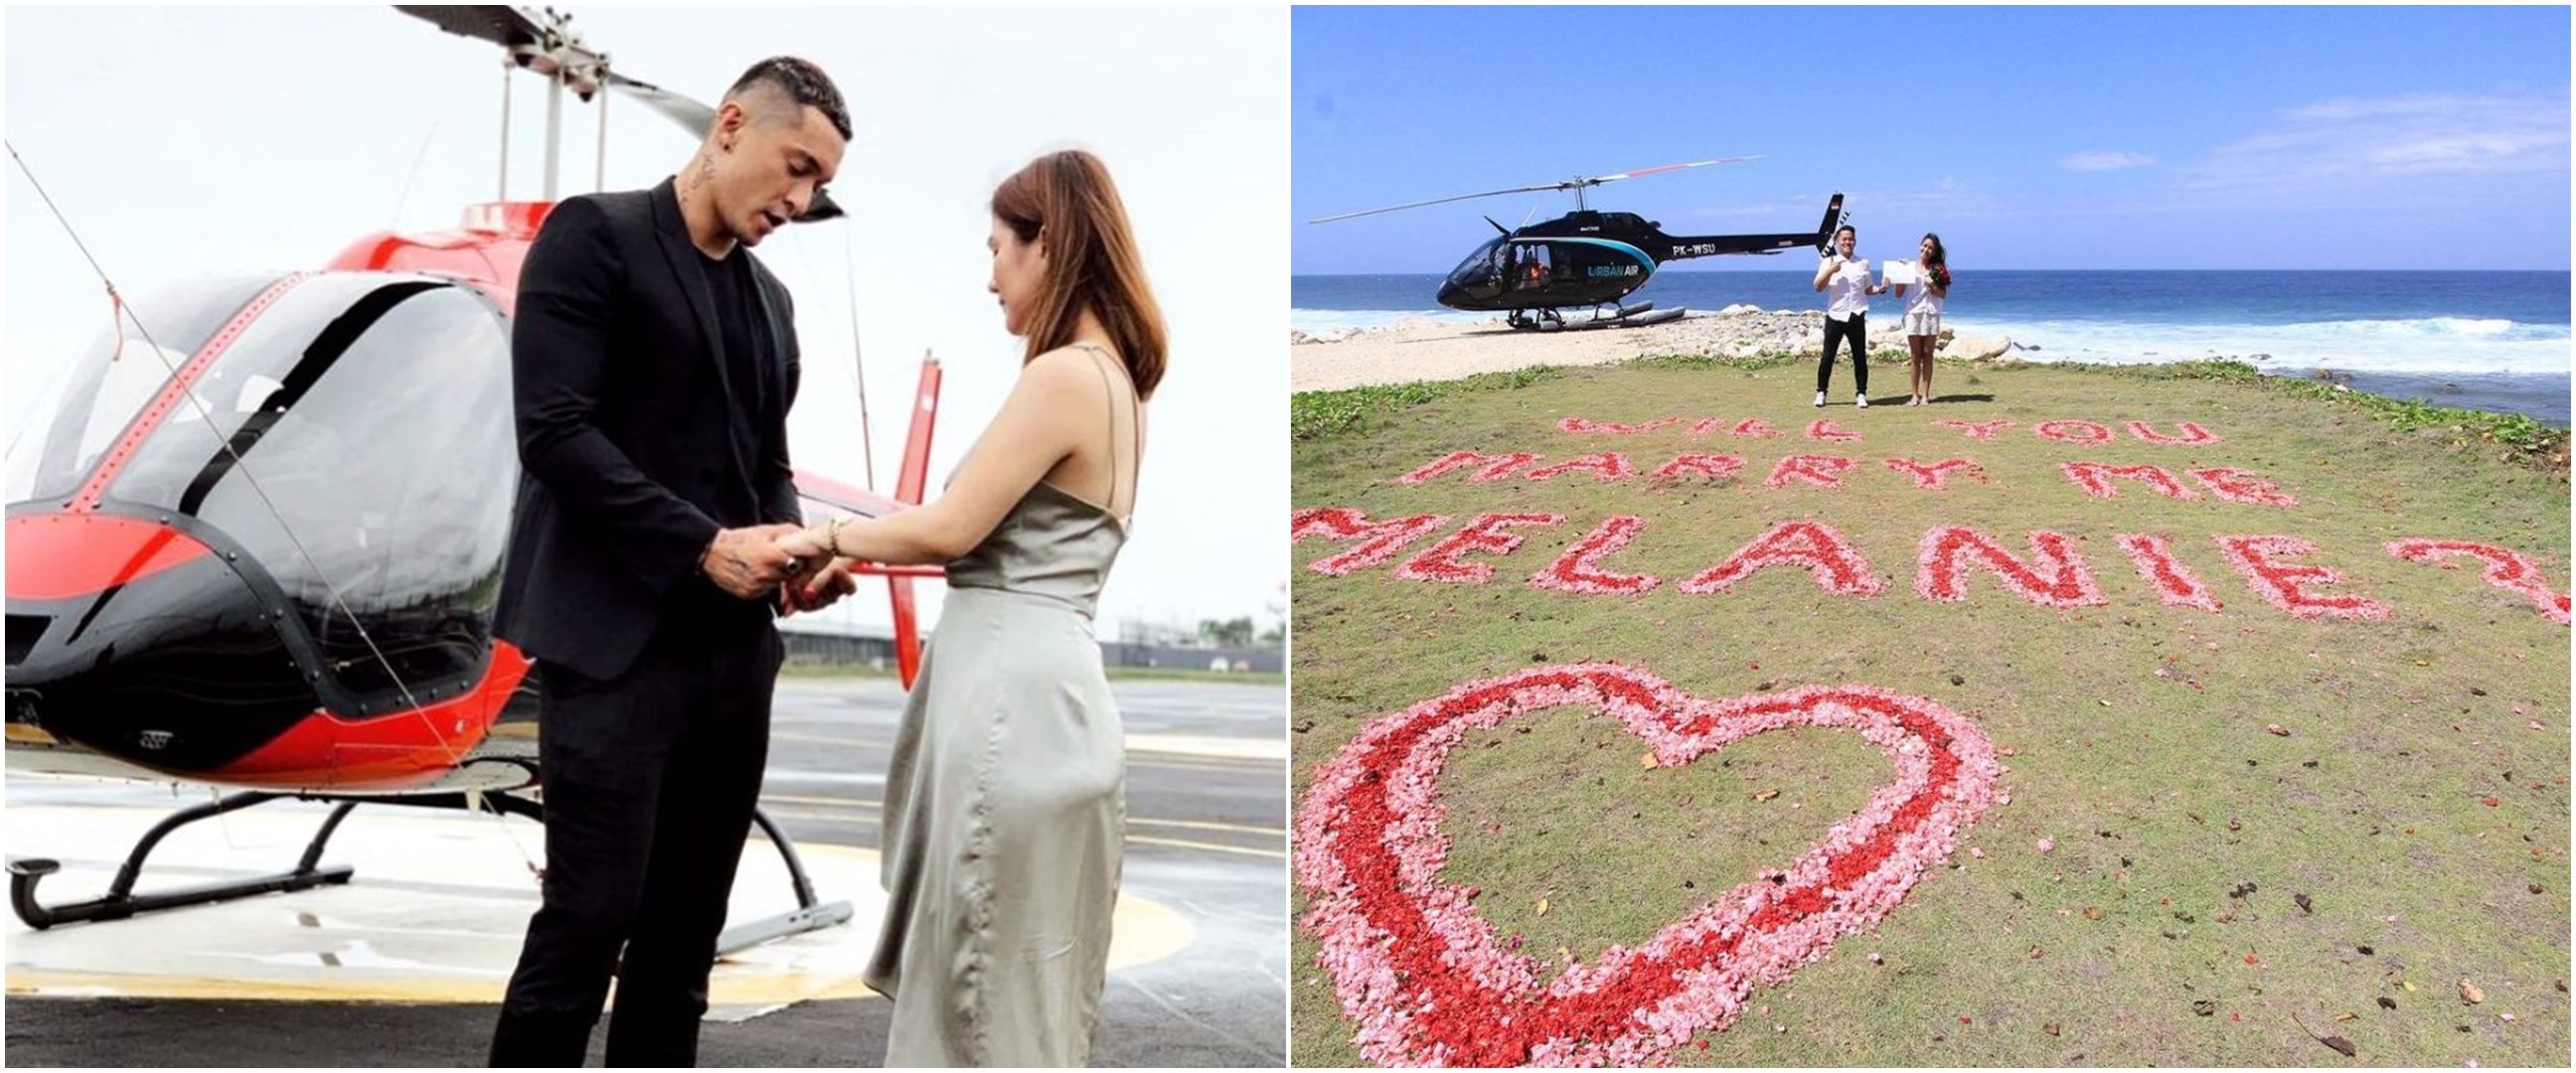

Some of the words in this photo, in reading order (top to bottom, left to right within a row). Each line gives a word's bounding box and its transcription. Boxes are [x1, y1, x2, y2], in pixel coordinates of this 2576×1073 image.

[1672, 243, 1716, 256] PK-WSU
[1624, 264, 1639, 276] AIR
[1554, 416, 1864, 442] WILL
[1931, 418, 2224, 447] YOU
[1393, 450, 1980, 490] MARRY
[2059, 460, 2300, 508] ME
